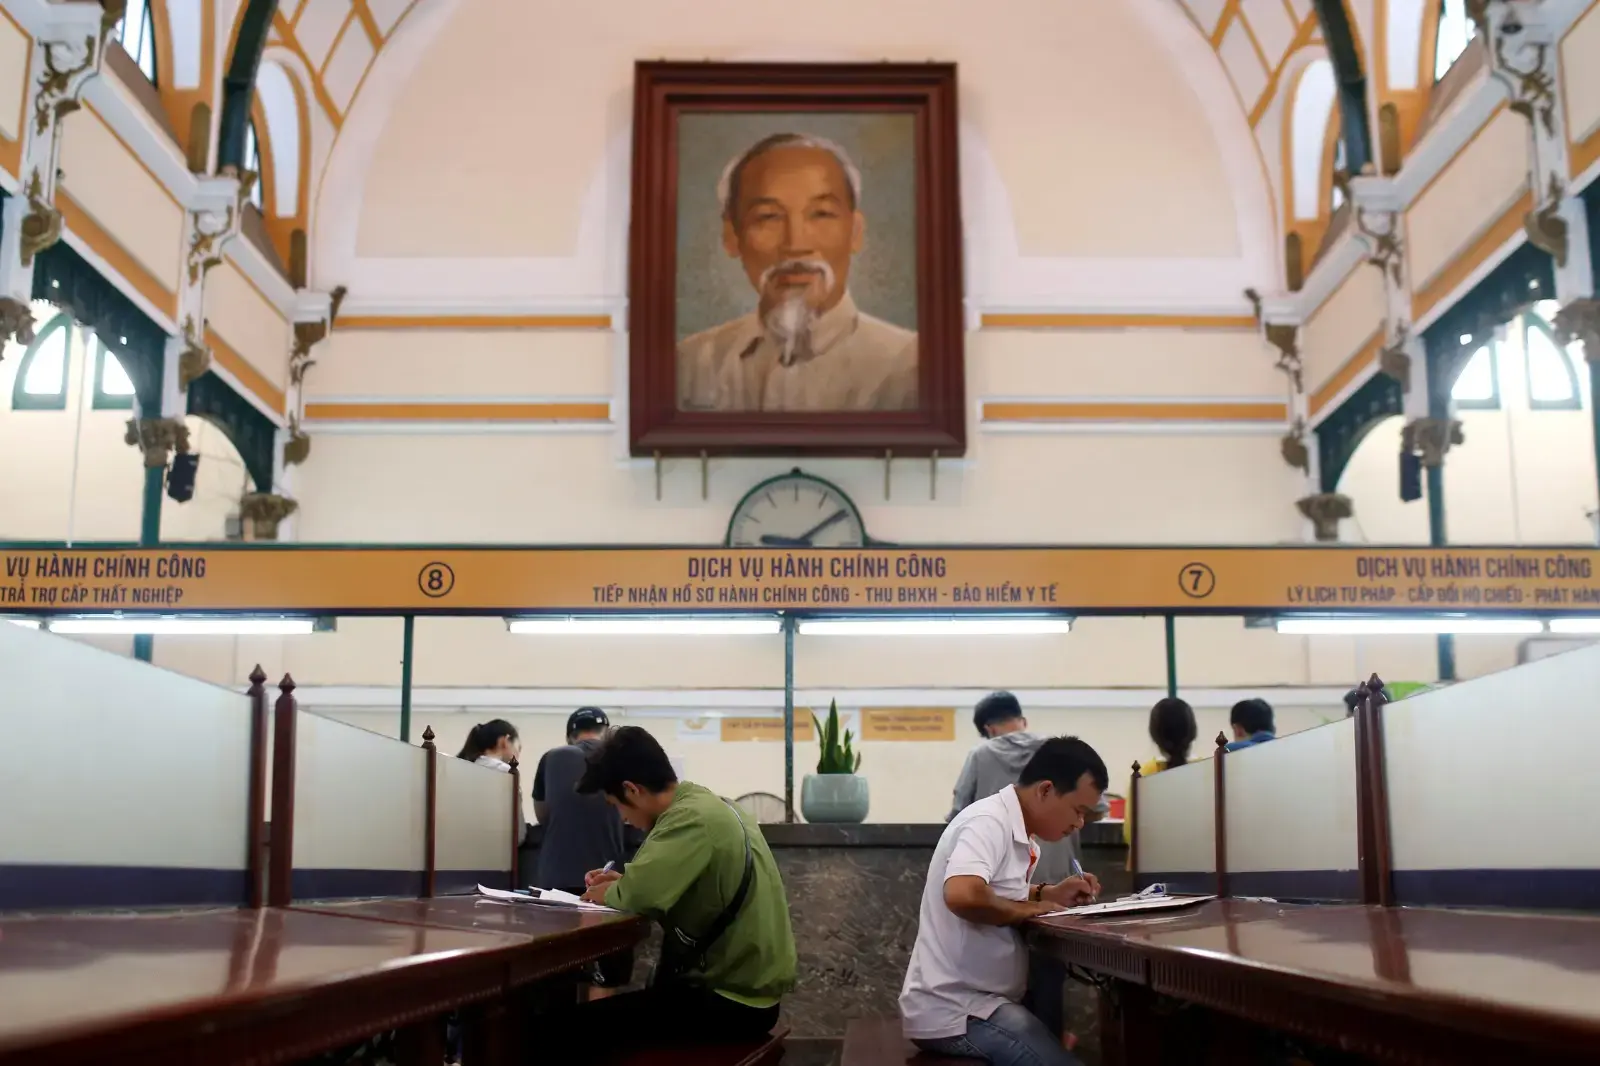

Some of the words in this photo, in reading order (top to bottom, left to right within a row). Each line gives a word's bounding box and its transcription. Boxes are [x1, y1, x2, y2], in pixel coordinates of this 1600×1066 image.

[6, 557, 30, 581] VỤ
[36, 553, 87, 578] HÀNH
[93, 554, 149, 578] CHÍNH
[156, 553, 206, 578] CÔNG
[428, 569, 443, 590] 8
[688, 557, 732, 581] DỊCH
[739, 557, 763, 582] VỤ
[771, 553, 823, 578] HÀNH
[830, 554, 888, 578] CHÍNH
[896, 553, 946, 578] CÔNG
[1356, 557, 1398, 581] DỊCH
[1402, 557, 1426, 582] VỤ
[1431, 554, 1481, 578] HÀNH
[1486, 554, 1540, 578] CHÍNH
[1545, 554, 1592, 578] CÔNG
[593, 583, 624, 603] TIẾP
[628, 584, 668, 605] NHẬN
[719, 584, 758, 603] HÀNH
[763, 584, 807, 603] CHÍNH
[812, 584, 849, 603] CÔNG
[866, 586, 892, 603] THU
[898, 586, 937, 603] BHXH
[953, 582, 981, 602] BẢO
[986, 580, 1021, 602] HIỂM
[1026, 586, 1036, 602] Y
[1040, 582, 1059, 602] TẾ
[1189, 570, 1203, 590] 7
[0, 582, 26, 603] TRẢ
[31, 587, 58, 605] TRỢ
[61, 583, 88, 603] CẤP
[93, 583, 127, 603] THẤT
[132, 585, 183, 605] NGHIỆP
